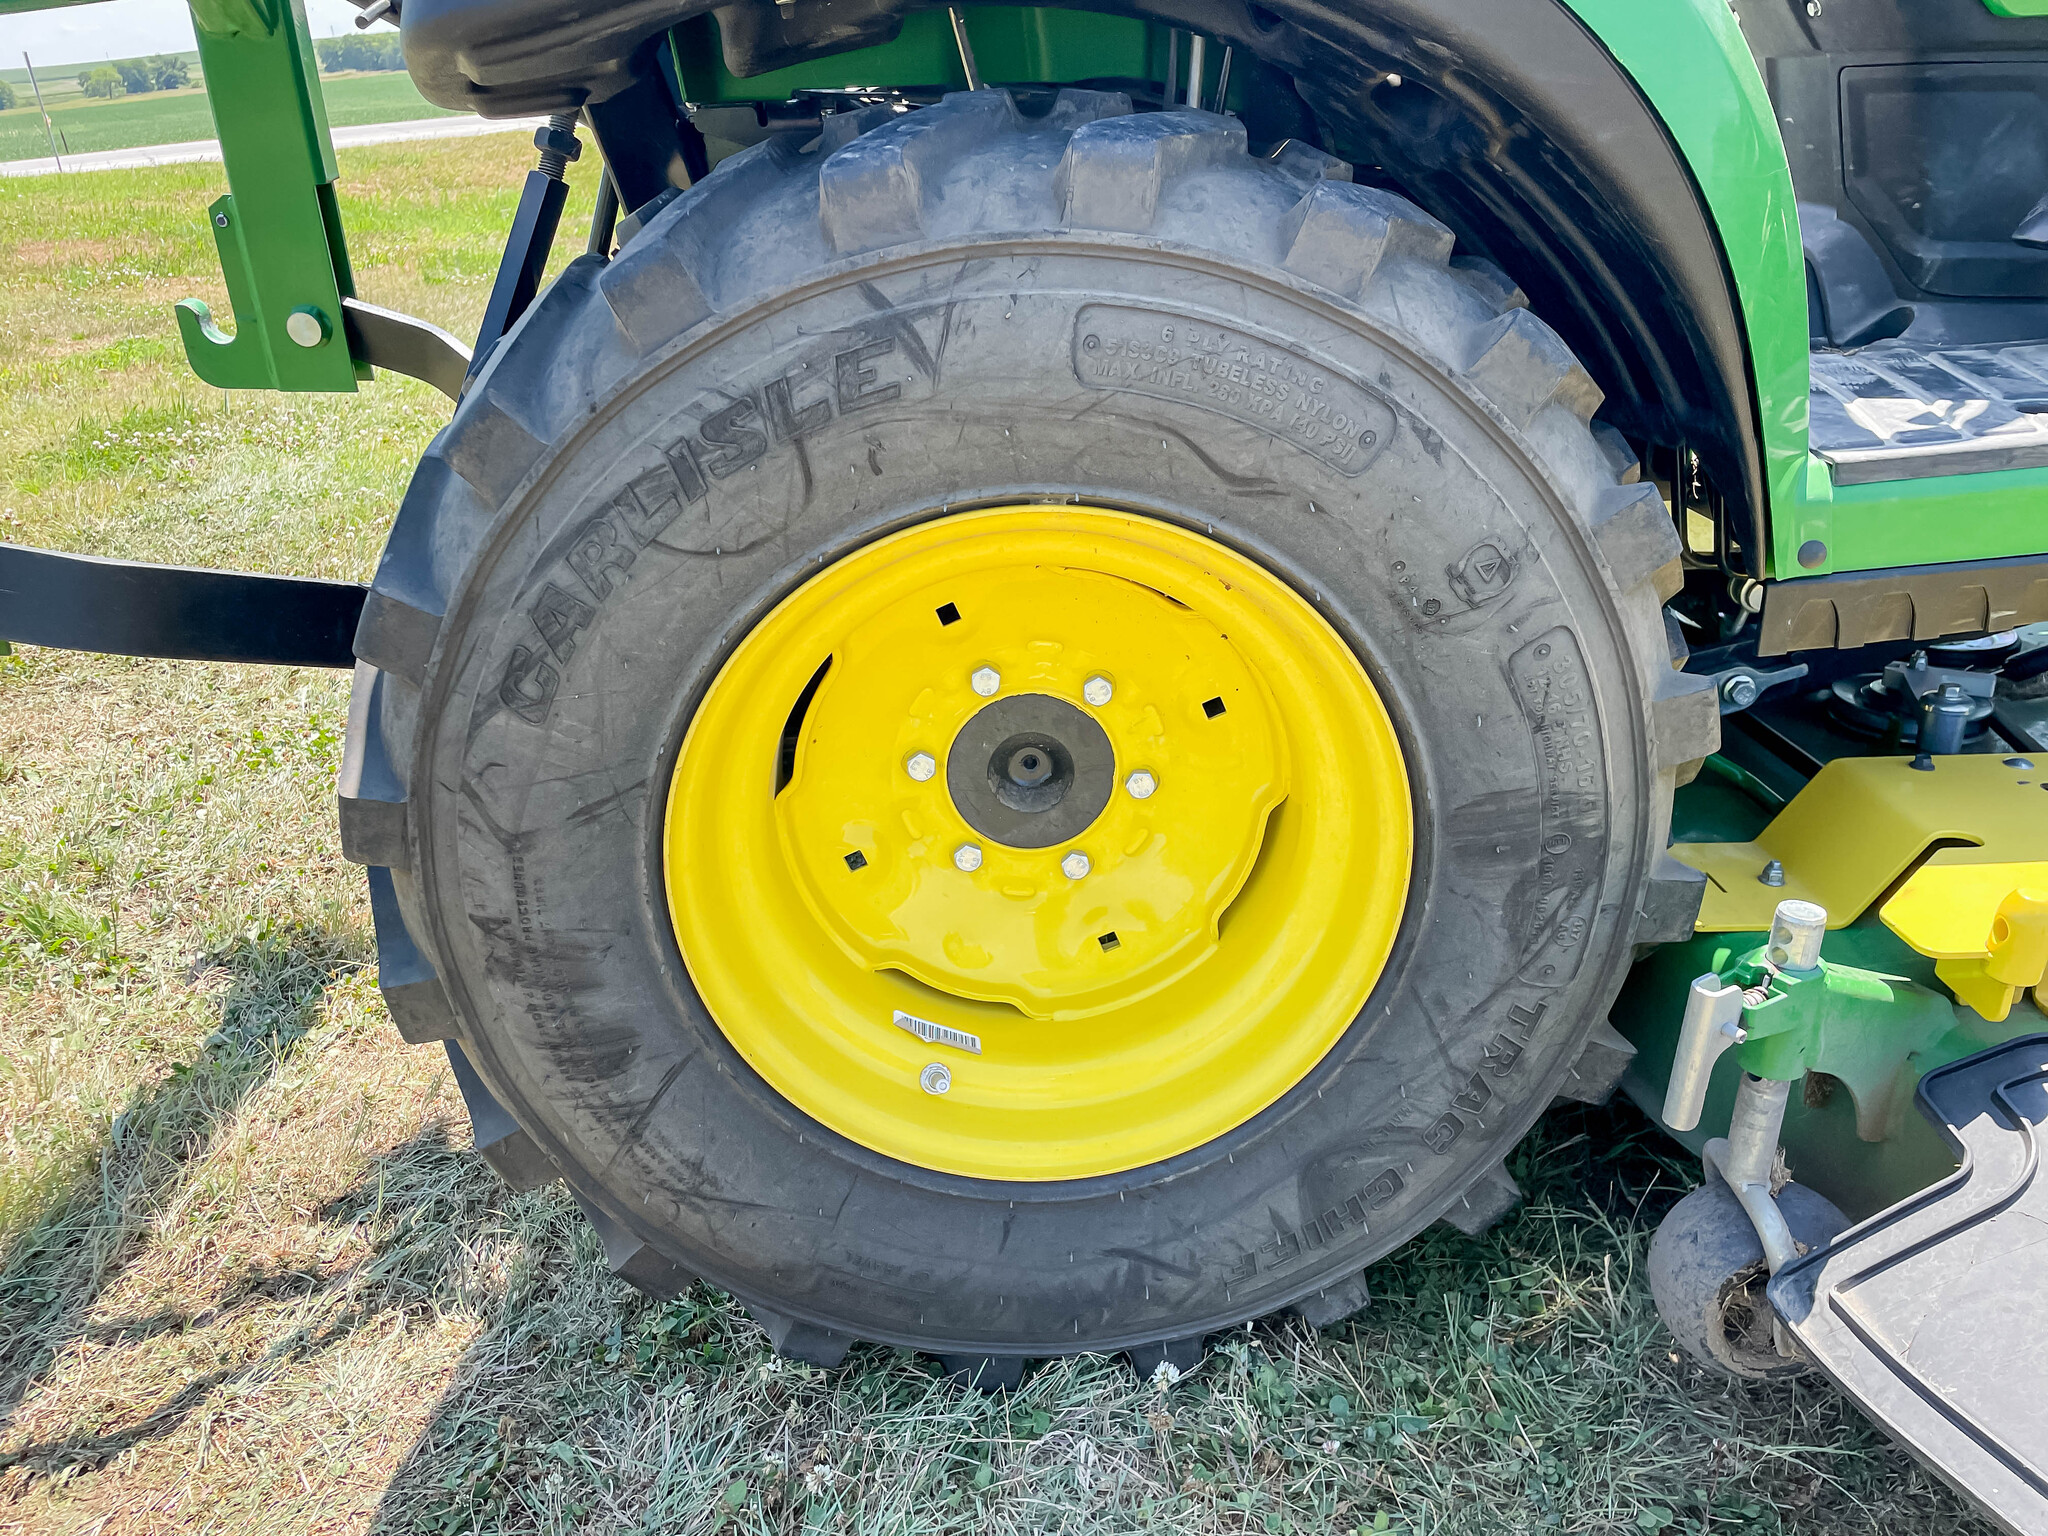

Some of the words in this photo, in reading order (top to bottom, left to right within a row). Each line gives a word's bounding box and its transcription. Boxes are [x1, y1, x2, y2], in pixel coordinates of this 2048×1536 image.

[1161, 325, 1175, 343] 6
[1187, 328, 1231, 354] PLY
[1236, 345, 1326, 394] RATING
[1192, 354, 1290, 400] TUBELESS
[1296, 393, 1360, 439] NYLON
[500, 335, 900, 725] CARLISLE
[1422, 1001, 1548, 1155] TRAC
[1223, 1167, 1406, 1290] CHIEF
